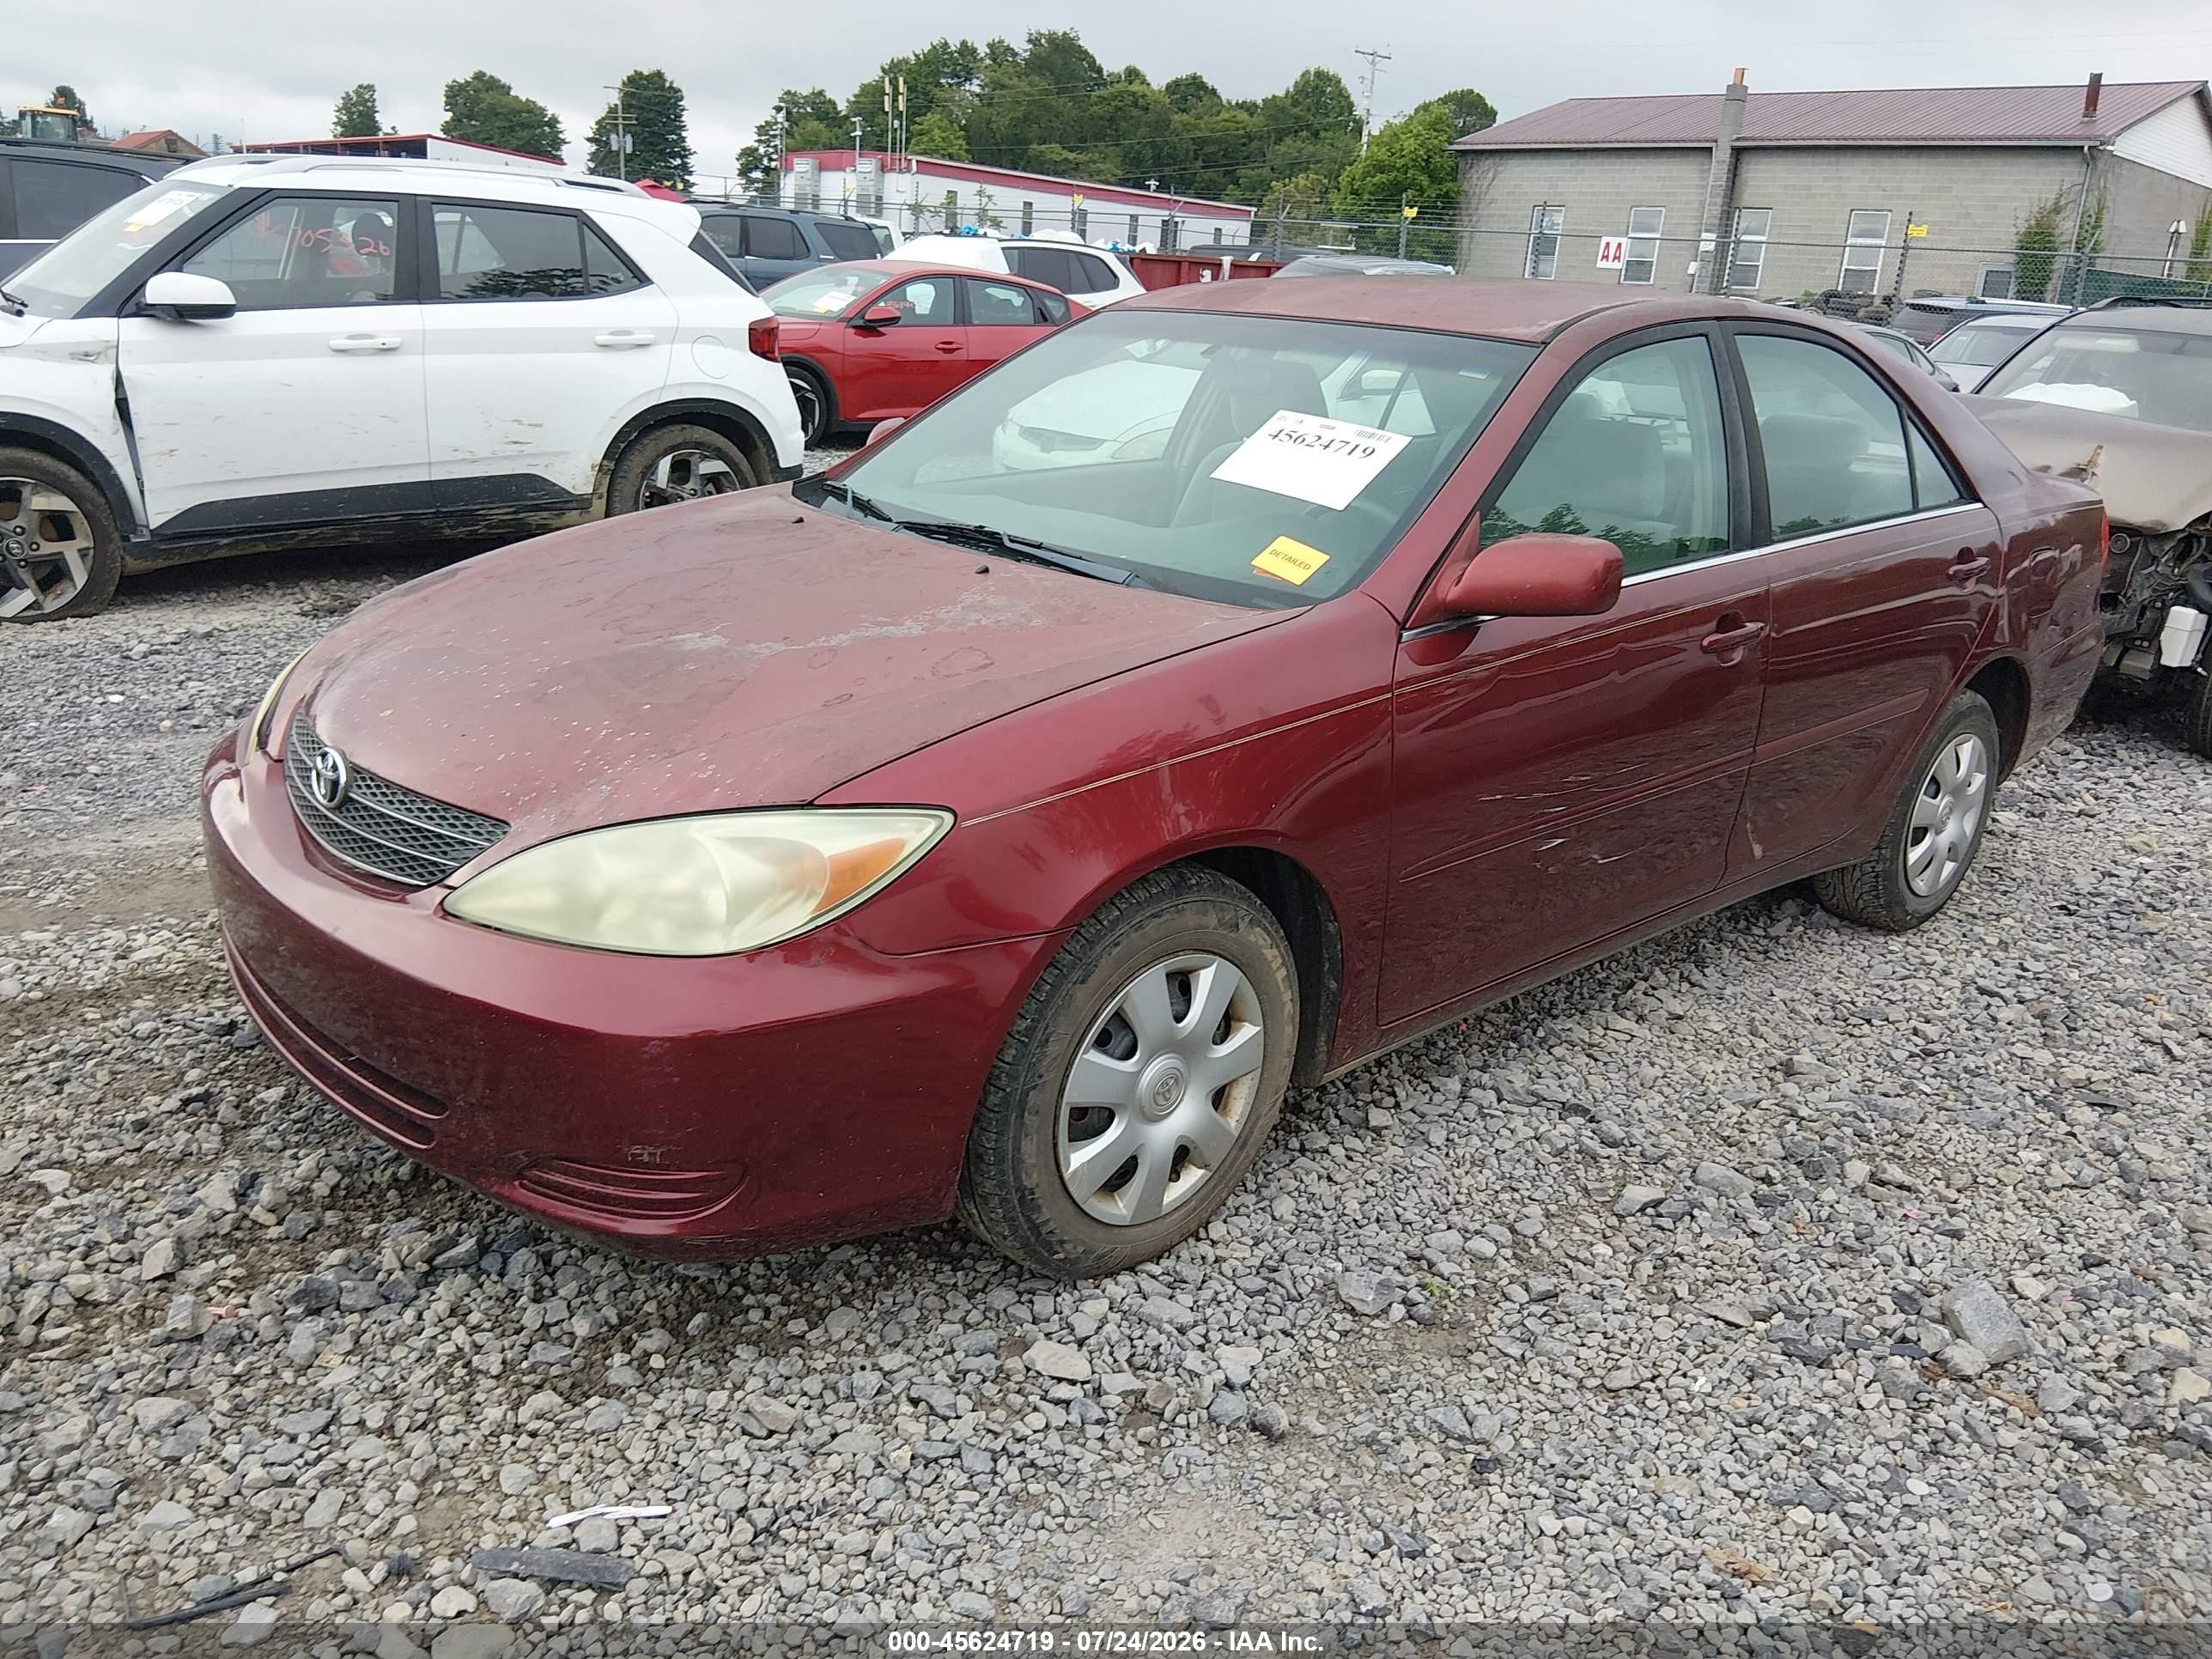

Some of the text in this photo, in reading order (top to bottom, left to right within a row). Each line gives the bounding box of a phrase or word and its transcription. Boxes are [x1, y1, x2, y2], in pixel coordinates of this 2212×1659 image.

[1601, 241, 1622, 263] AA
[1268, 428, 1376, 459] 45624719
[1269, 549, 1311, 570] DETAILED
